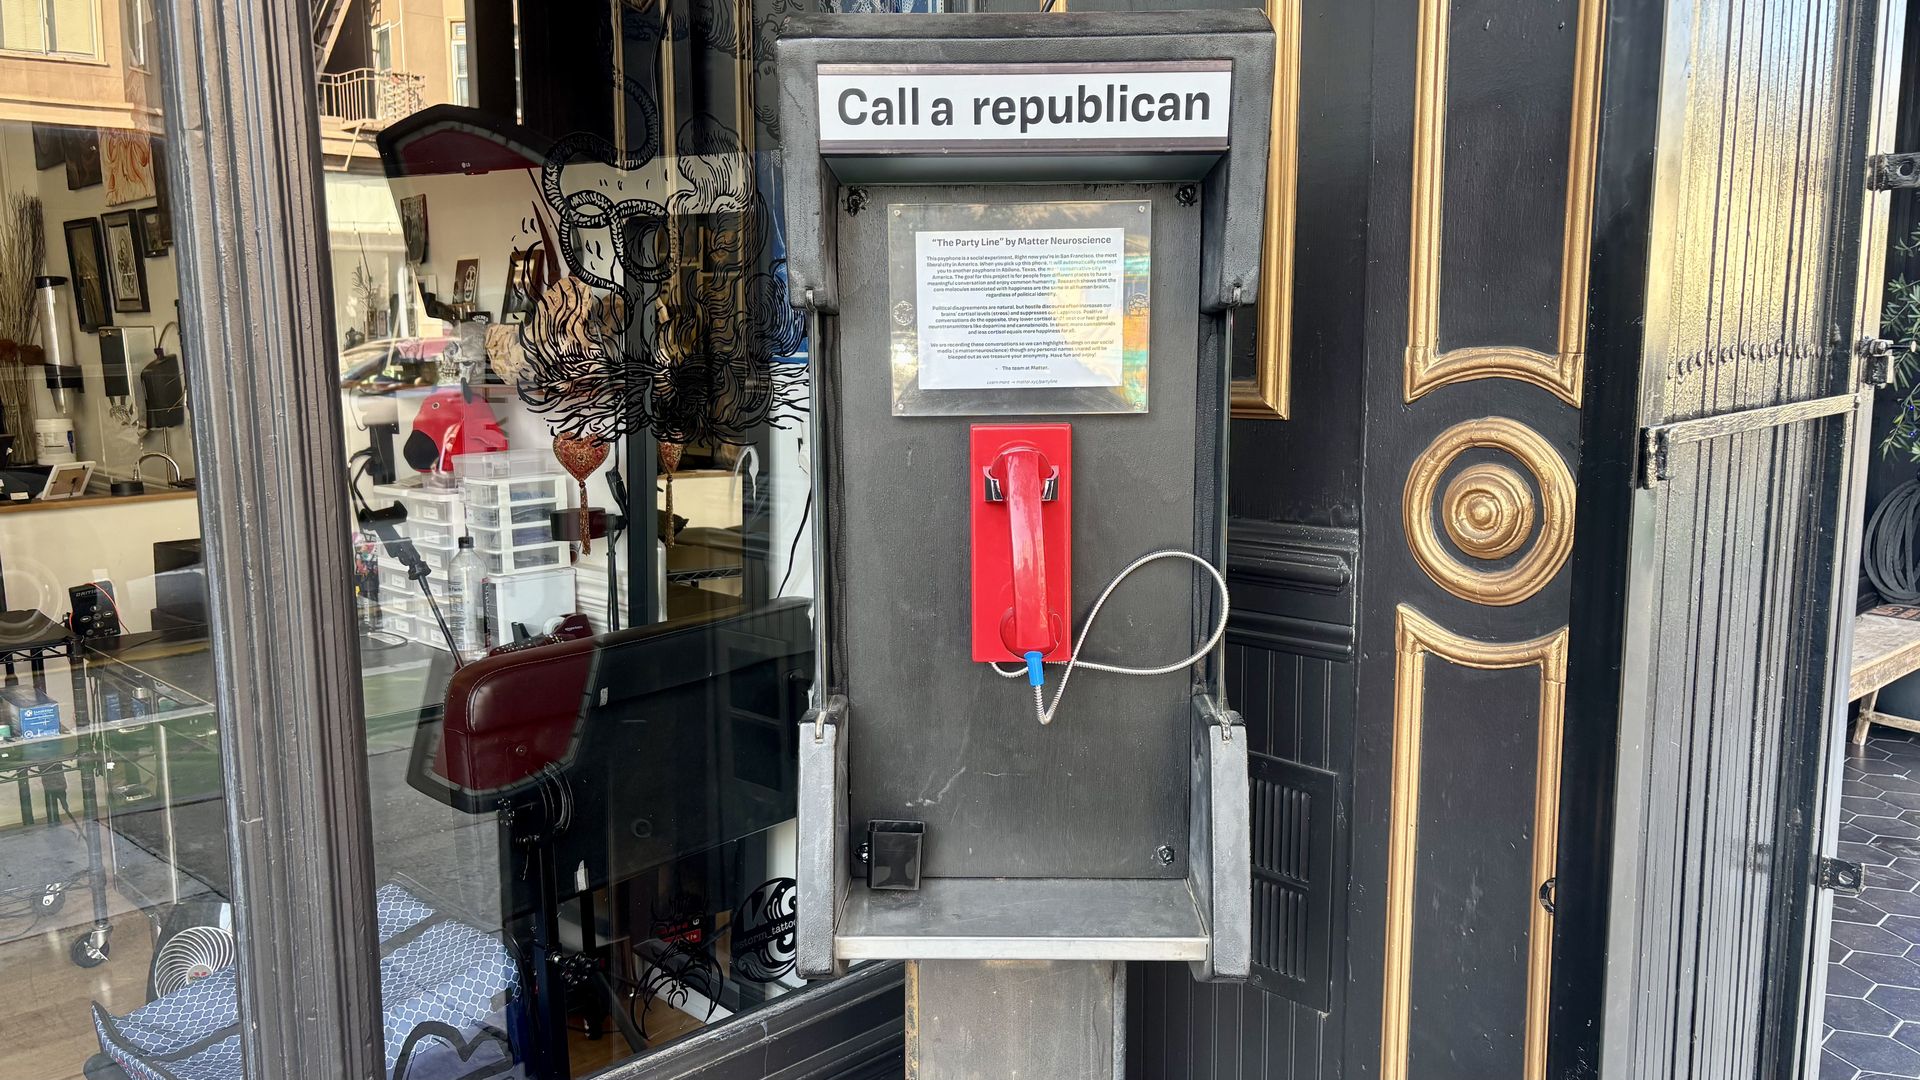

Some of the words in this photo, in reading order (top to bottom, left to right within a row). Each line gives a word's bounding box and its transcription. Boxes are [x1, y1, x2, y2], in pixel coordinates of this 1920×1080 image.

[838, 87, 919, 126] Call
[931, 96, 954, 126] a
[973, 84, 1210, 133] republican
[956, 238, 979, 248] Party
[1006, 238, 1016, 247] by
[1051, 236, 1111, 244] Neuroscience
